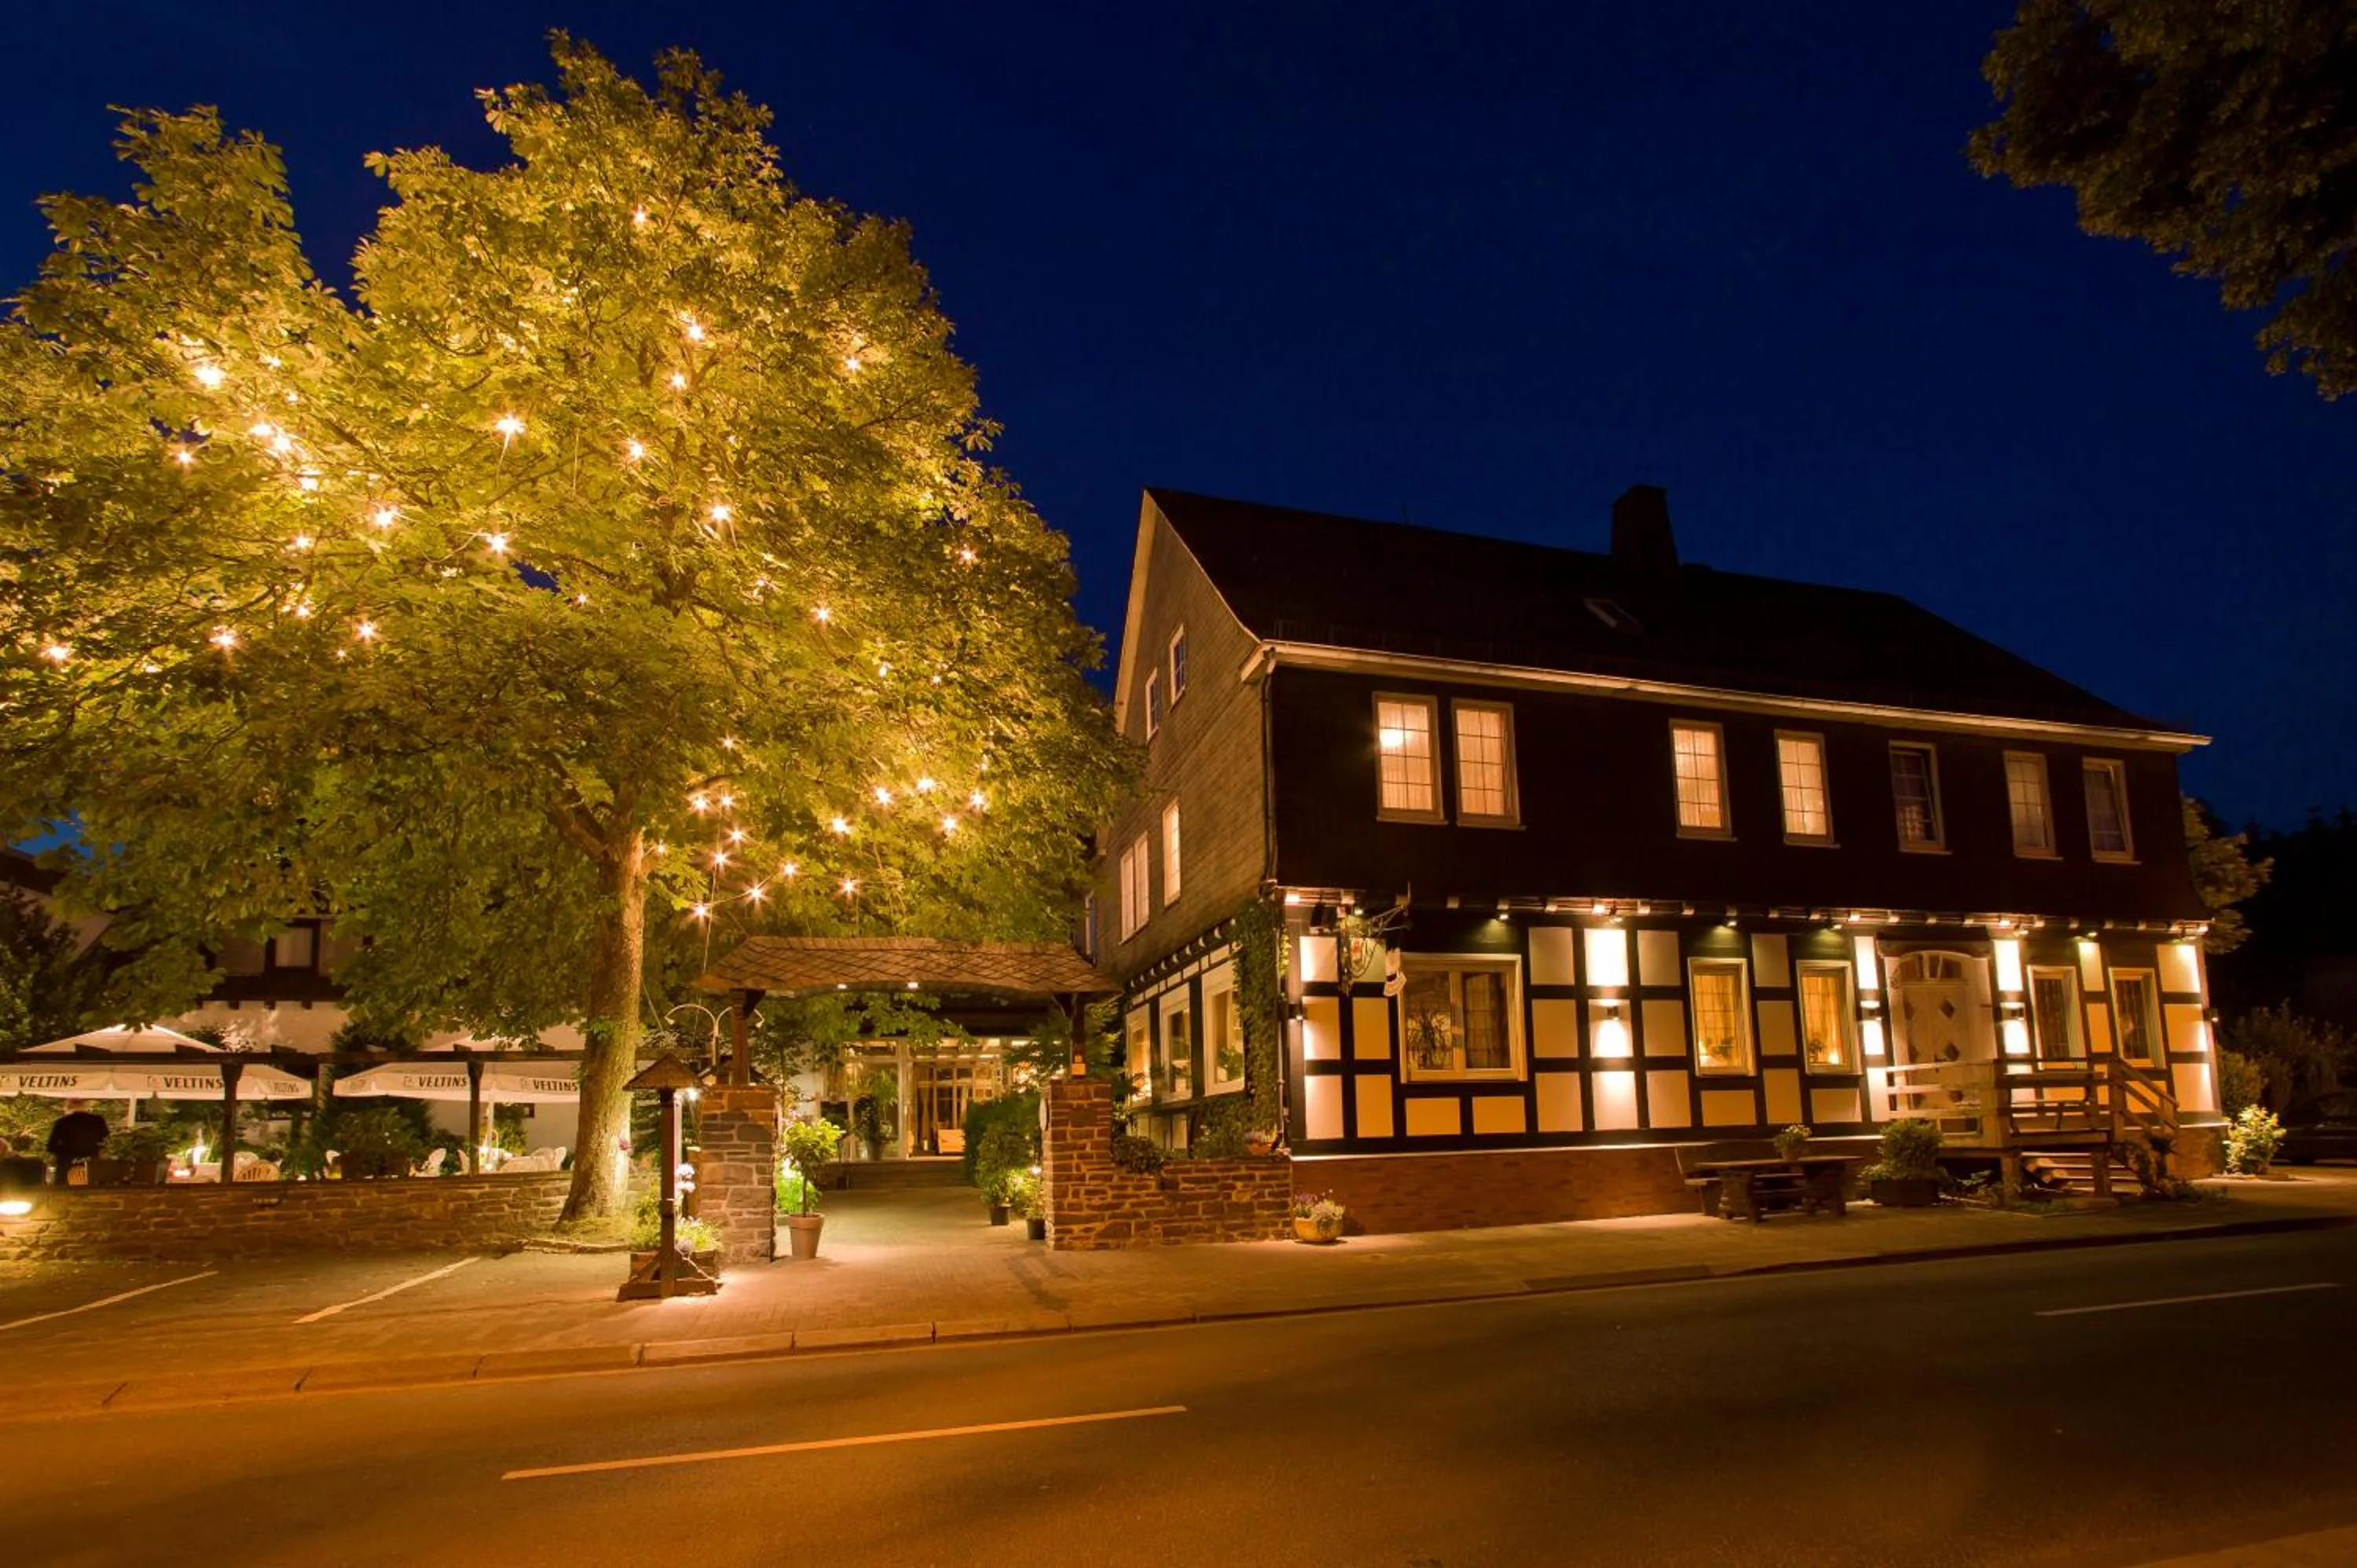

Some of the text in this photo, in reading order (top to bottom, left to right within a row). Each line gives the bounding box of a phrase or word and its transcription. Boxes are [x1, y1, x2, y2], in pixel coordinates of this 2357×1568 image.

[19, 1075, 79, 1088] VELTINS
[163, 1077, 224, 1090] VELTINS
[419, 1075, 467, 1088] VELTINS
[533, 1079, 577, 1091] VELTINS
